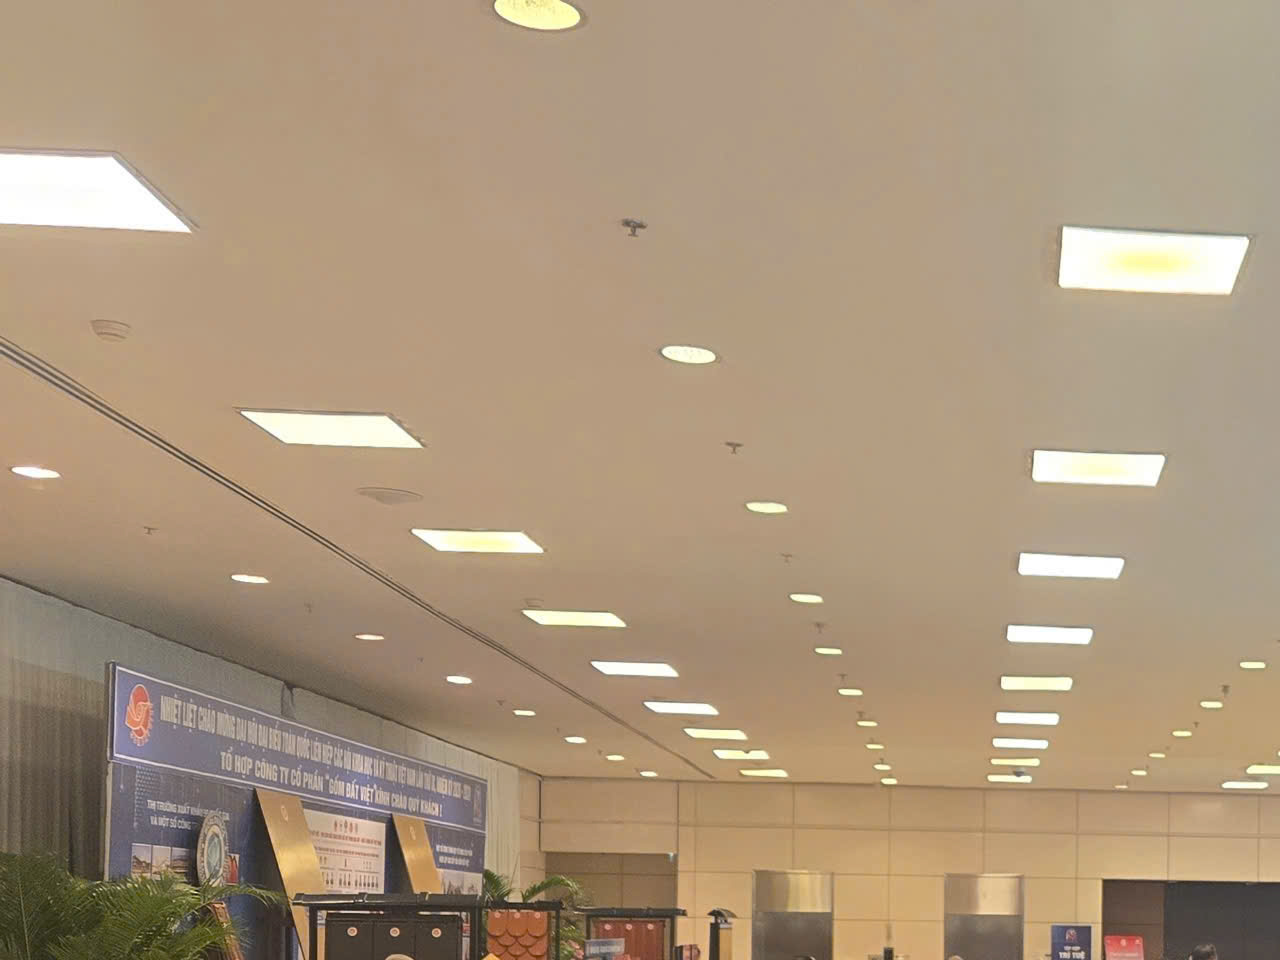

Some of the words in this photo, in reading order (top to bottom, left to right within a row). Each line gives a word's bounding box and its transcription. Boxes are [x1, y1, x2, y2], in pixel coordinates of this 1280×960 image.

[220, 746, 233, 772] TỔ
[234, 754, 253, 779] HỢP
[254, 758, 278, 782] CÔNG
[279, 766, 289, 785] TY
[290, 764, 302, 787] CỔ
